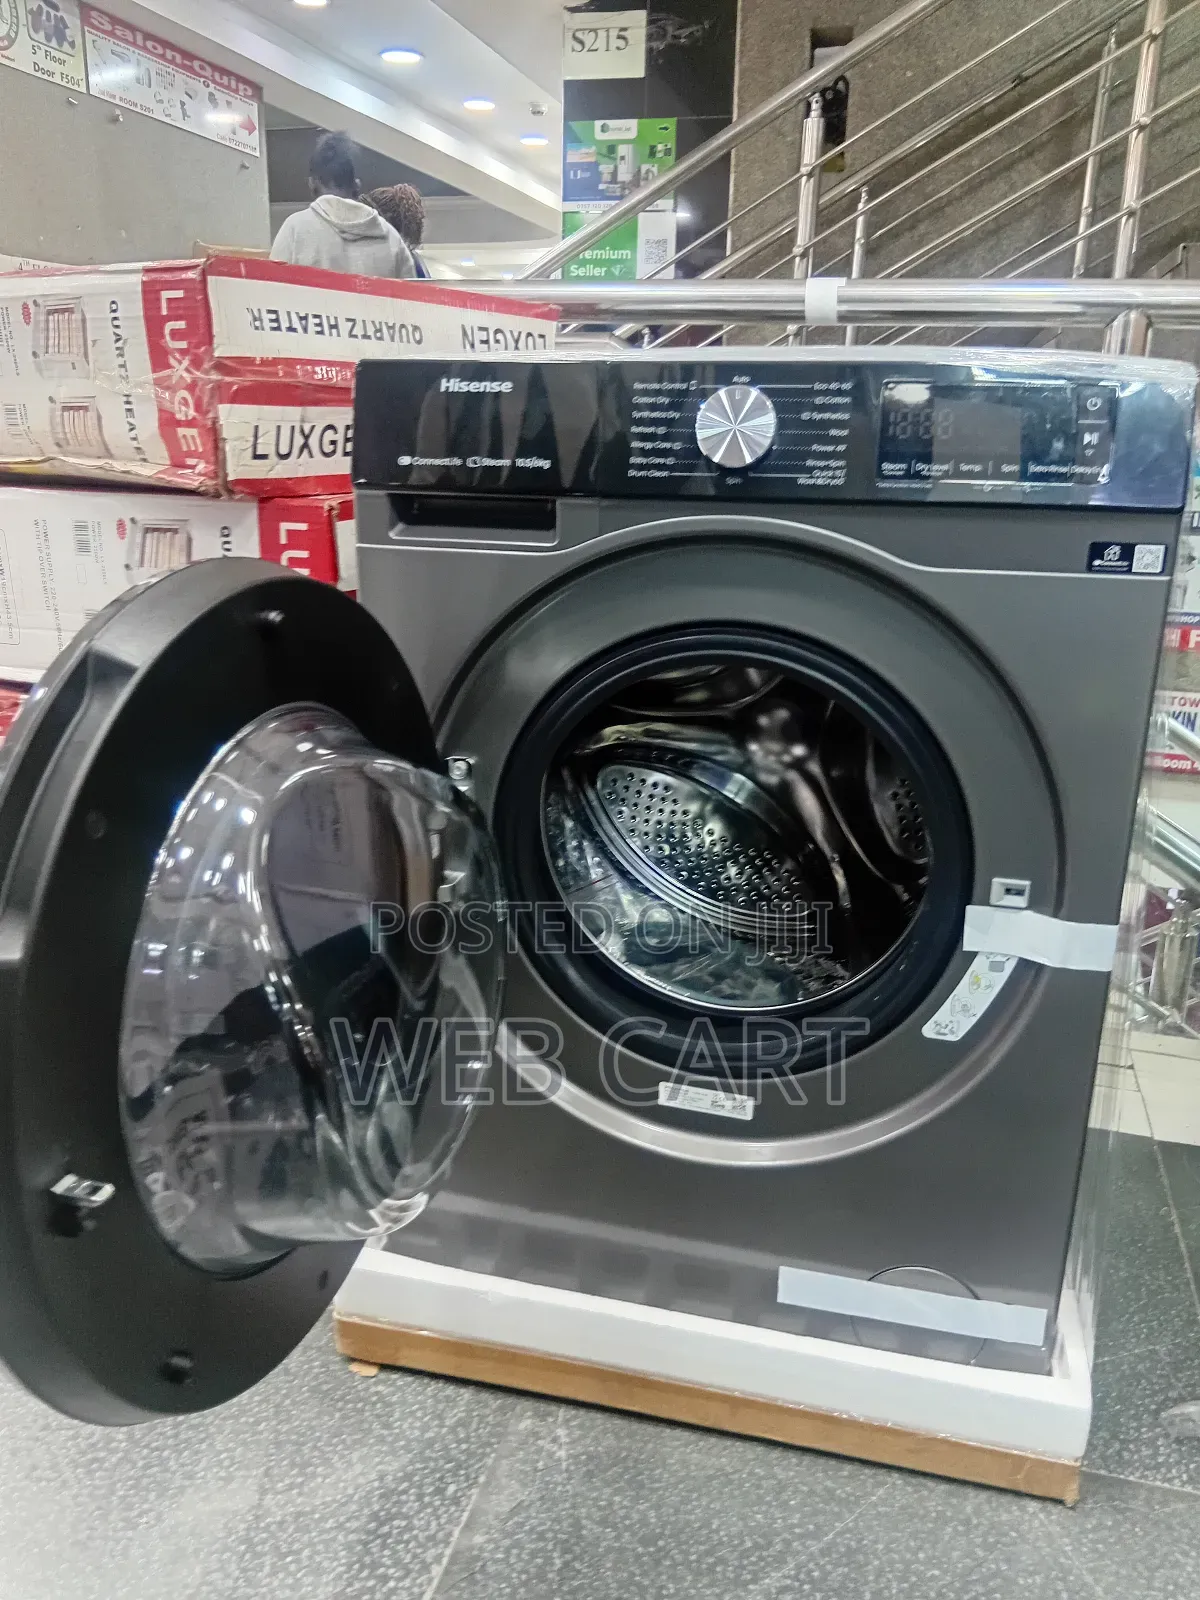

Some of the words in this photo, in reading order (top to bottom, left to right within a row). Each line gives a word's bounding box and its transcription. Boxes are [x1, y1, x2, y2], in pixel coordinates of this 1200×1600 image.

[571, 27, 630, 53] S215
[44, 49, 67, 67] Floor
[89, 10, 253, 97] Salon-Quip
[32, 61, 56, 79] Door
[118, 96, 138, 109] ROOM
[139, 103, 155, 115] S201
[579, 246, 631, 260] remium
[570, 264, 607, 277] Seller
[246, 307, 341, 338] HEATER
[345, 317, 424, 346] QUARTZ
[461, 323, 547, 353] LUXGEN
[440, 378, 514, 393] Hisense
[482, 457, 512, 468] Steam
[33, 518, 42, 540] WITH
[42, 519, 50, 549] POWER
[36, 541, 44, 553] TIP
[220, 525, 232, 557] QU
[38, 555, 46, 579] OVER
[41, 580, 52, 611] SWITCH
